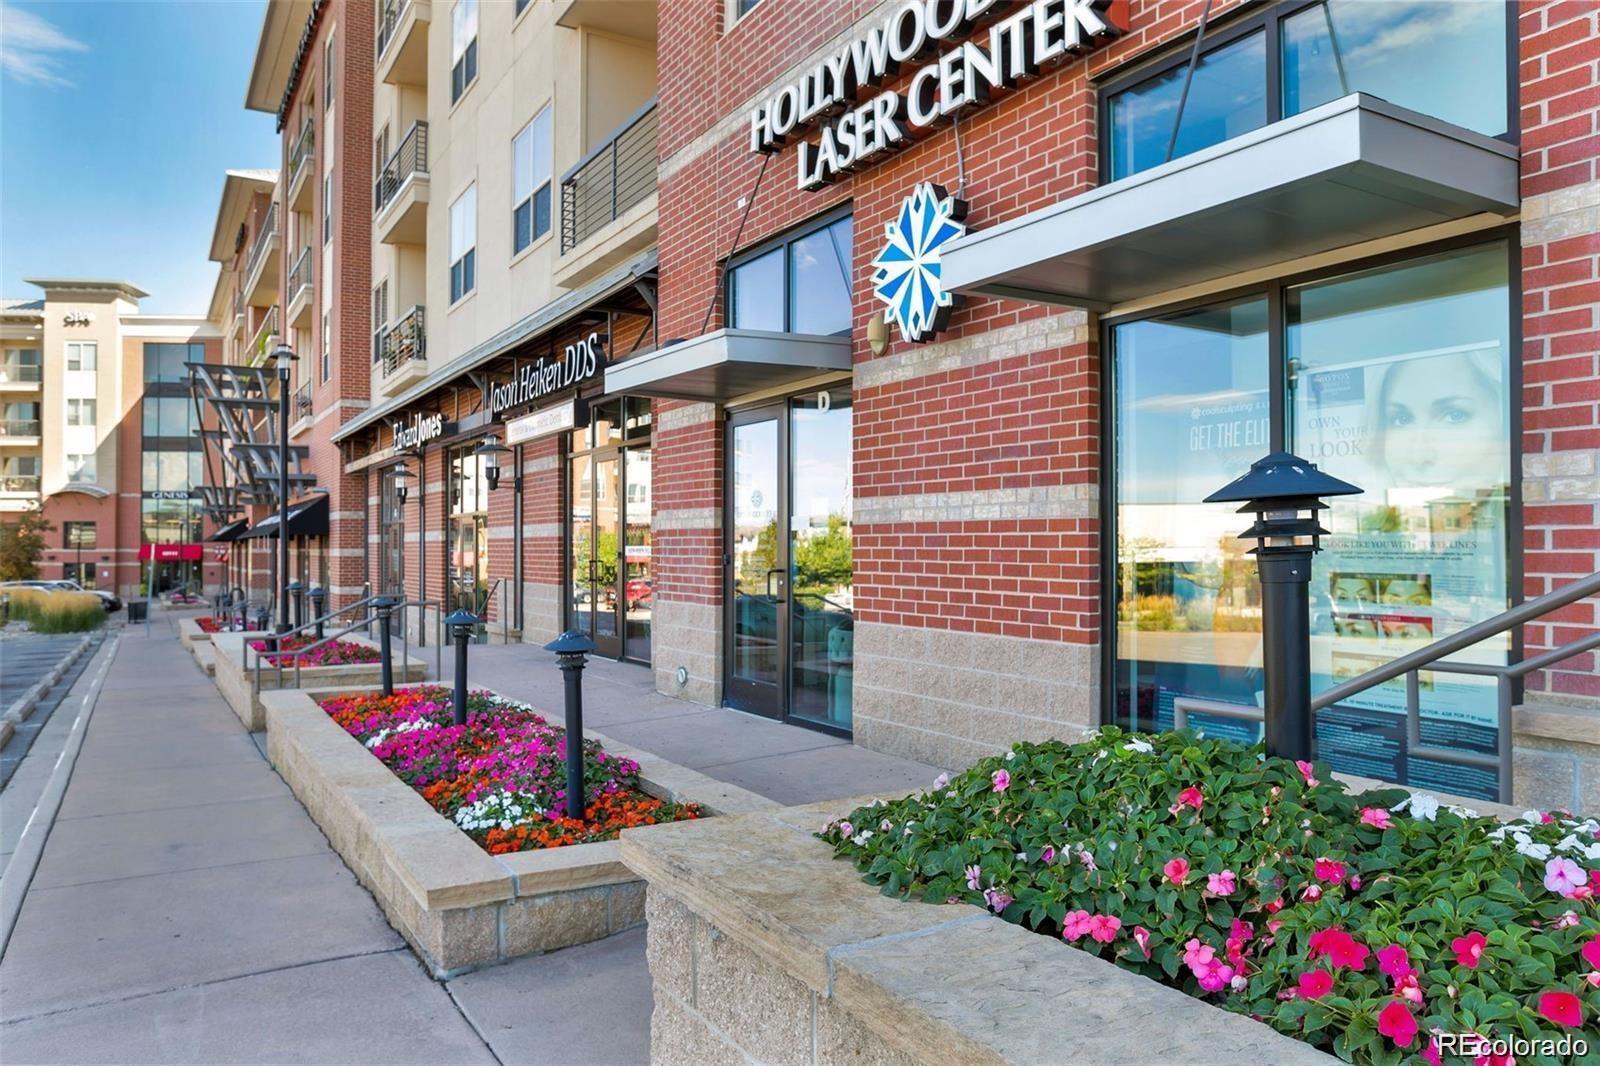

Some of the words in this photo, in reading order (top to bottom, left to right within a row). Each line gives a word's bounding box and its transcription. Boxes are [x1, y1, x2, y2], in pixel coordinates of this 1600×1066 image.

[797, 90, 905, 191] LASER
[907, 0, 1107, 128] CENTER
[489, 380, 518, 423] Jason
[518, 357, 561, 404] Heiken
[563, 332, 597, 387] DDS
[818, 391, 831, 414] D
[417, 412, 442, 447] Jones
[1308, 415, 1341, 430] OWN
[1334, 425, 1369, 439] YOUR
[1190, 424, 1214, 451] GET
[1216, 421, 1241, 448] THE
[1310, 439, 1362, 459] LOOK
[152, 491, 188, 499] GENESIS
[1371, 541, 1391, 549] YOU
